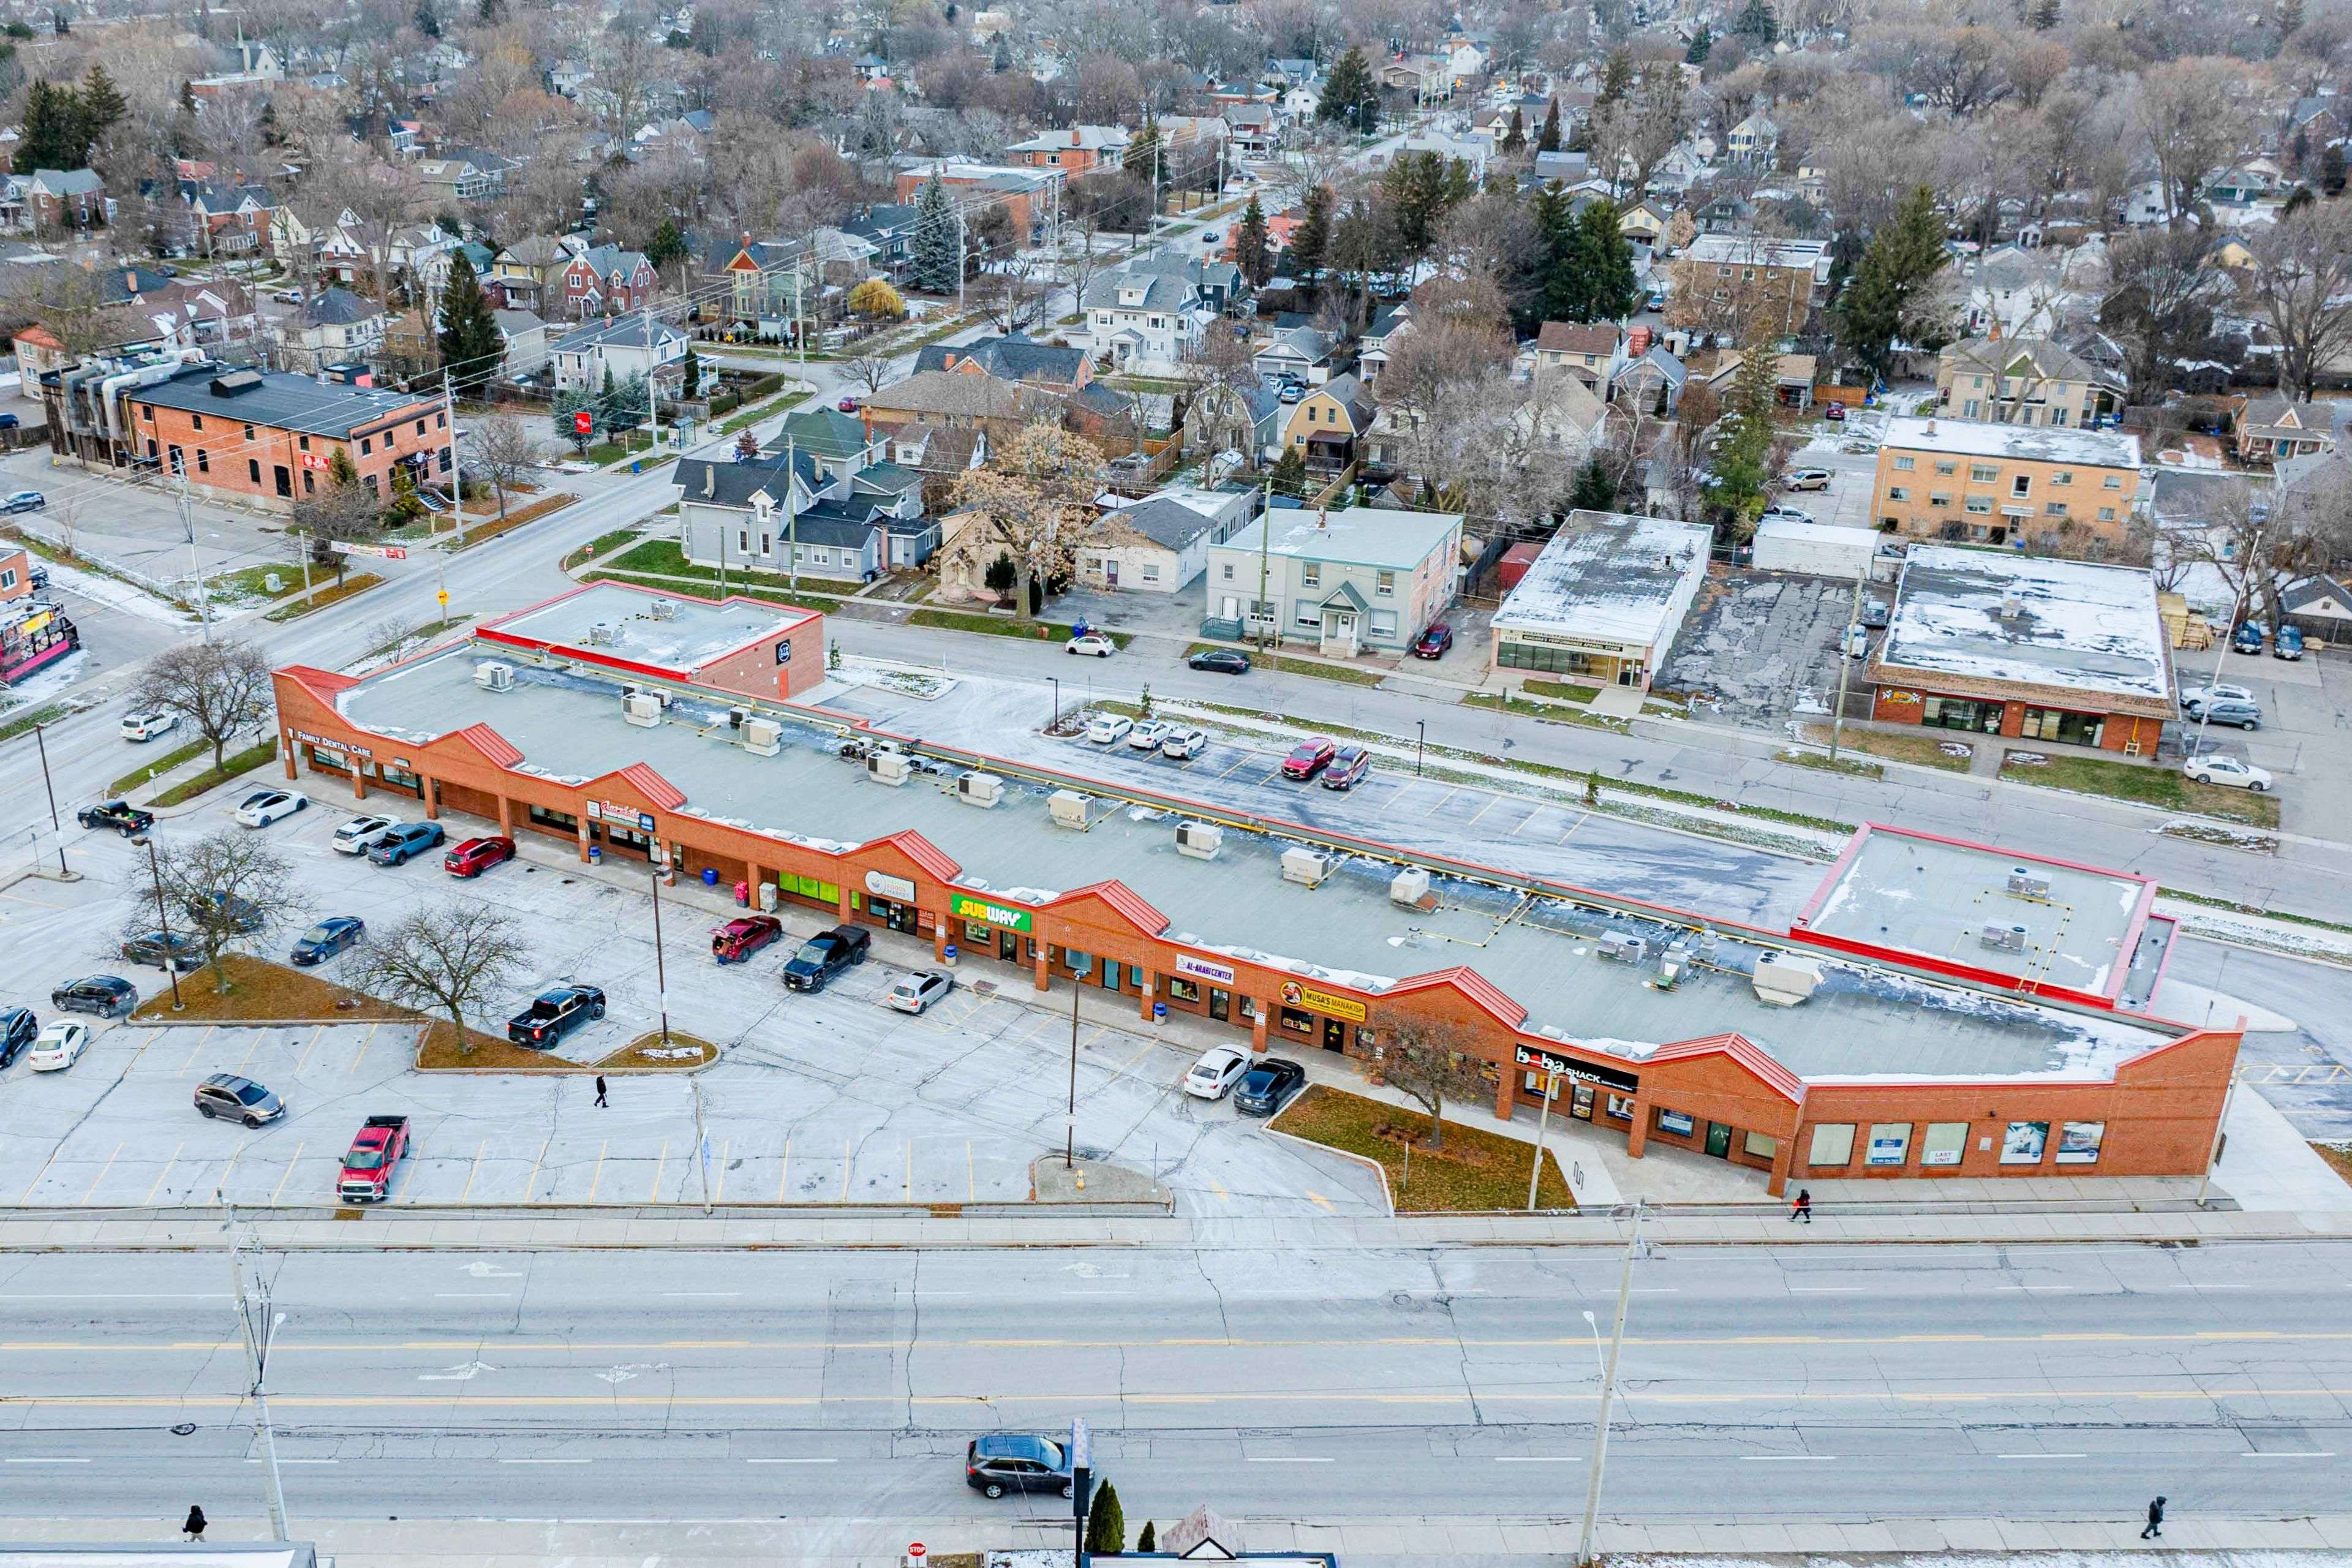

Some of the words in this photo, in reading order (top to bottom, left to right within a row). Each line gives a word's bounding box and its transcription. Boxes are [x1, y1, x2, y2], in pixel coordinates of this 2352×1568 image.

[298, 731, 320, 744] FAMILY
[322, 737, 350, 752] DENTAL
[352, 745, 372, 757] CARE
[959, 900, 1022, 927] SUBWAY
[1211, 968, 1232, 980] CENTER
[1306, 992, 1331, 1005] MUSA'S
[1331, 998, 1364, 1014] MANAKISH
[1564, 1068, 1601, 1084] SHACK
